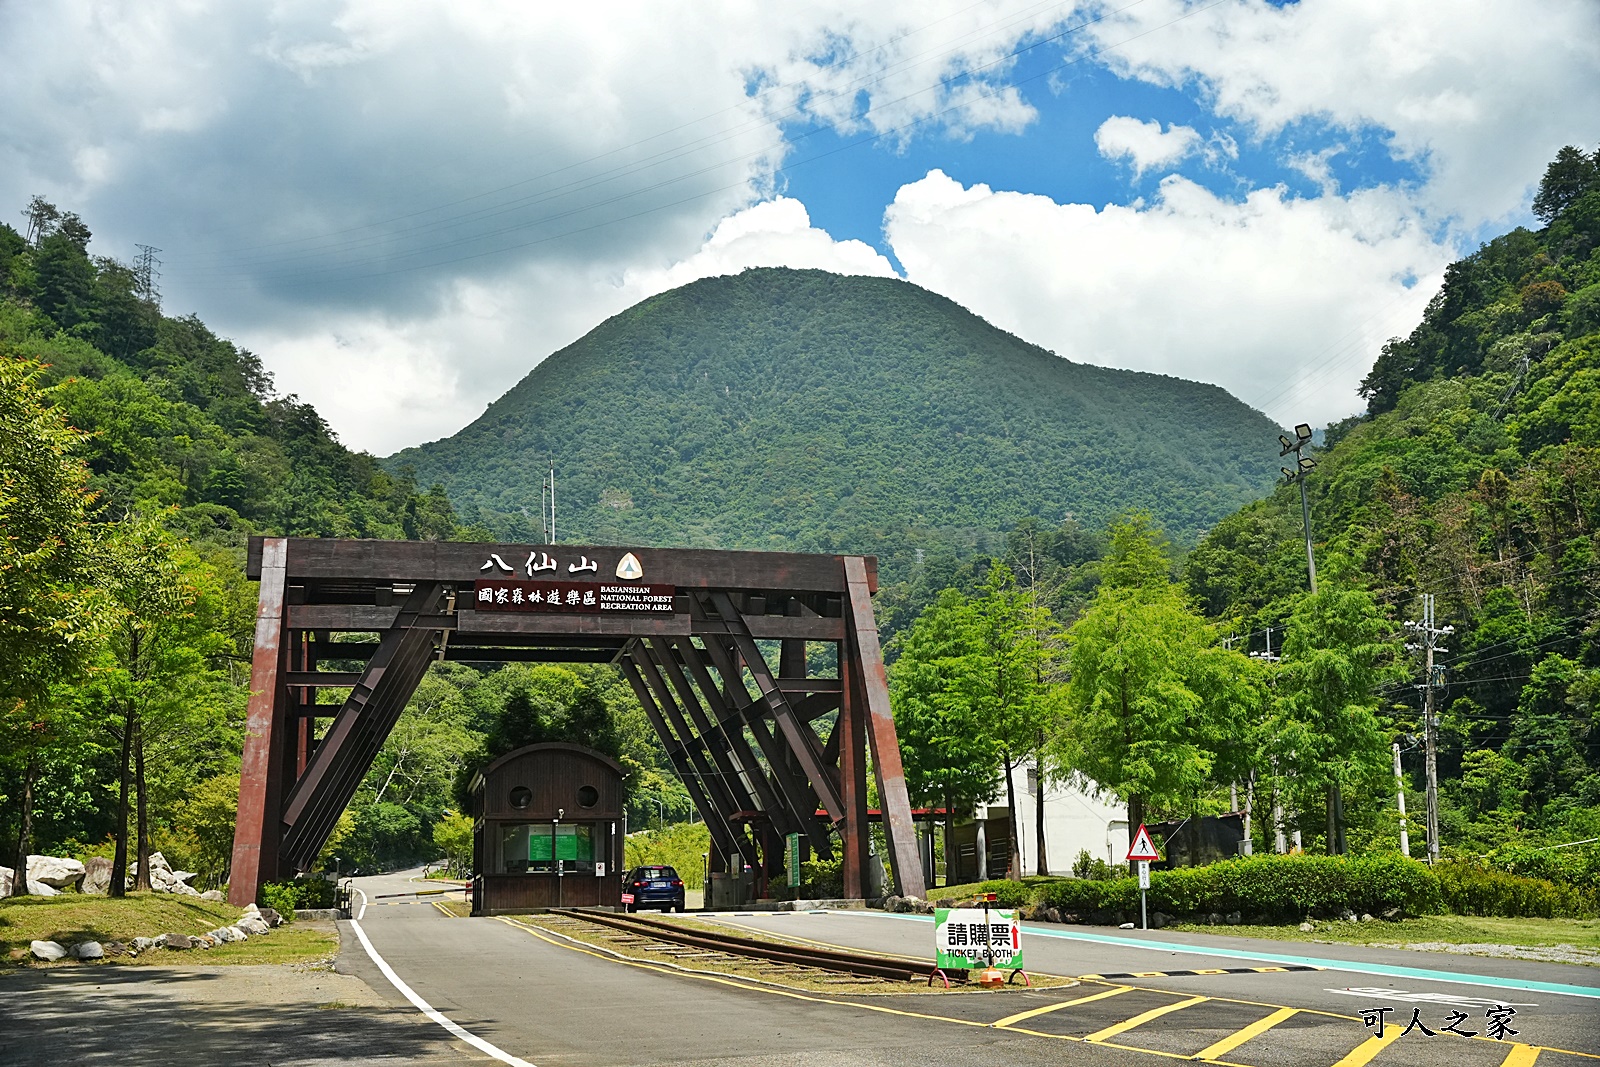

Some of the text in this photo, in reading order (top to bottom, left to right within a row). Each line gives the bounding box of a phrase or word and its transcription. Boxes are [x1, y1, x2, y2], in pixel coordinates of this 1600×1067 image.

[480, 551, 598, 577] 八仙山
[600, 586, 650, 594] BASIANSHAN
[478, 587, 597, 606] 國家森林遊樂區
[600, 594, 673, 603] NATIONAL FOREST
[600, 602, 651, 610] RECREATION
[947, 923, 1011, 947] 請購票
[946, 948, 1013, 958] TICKET BOOTH
